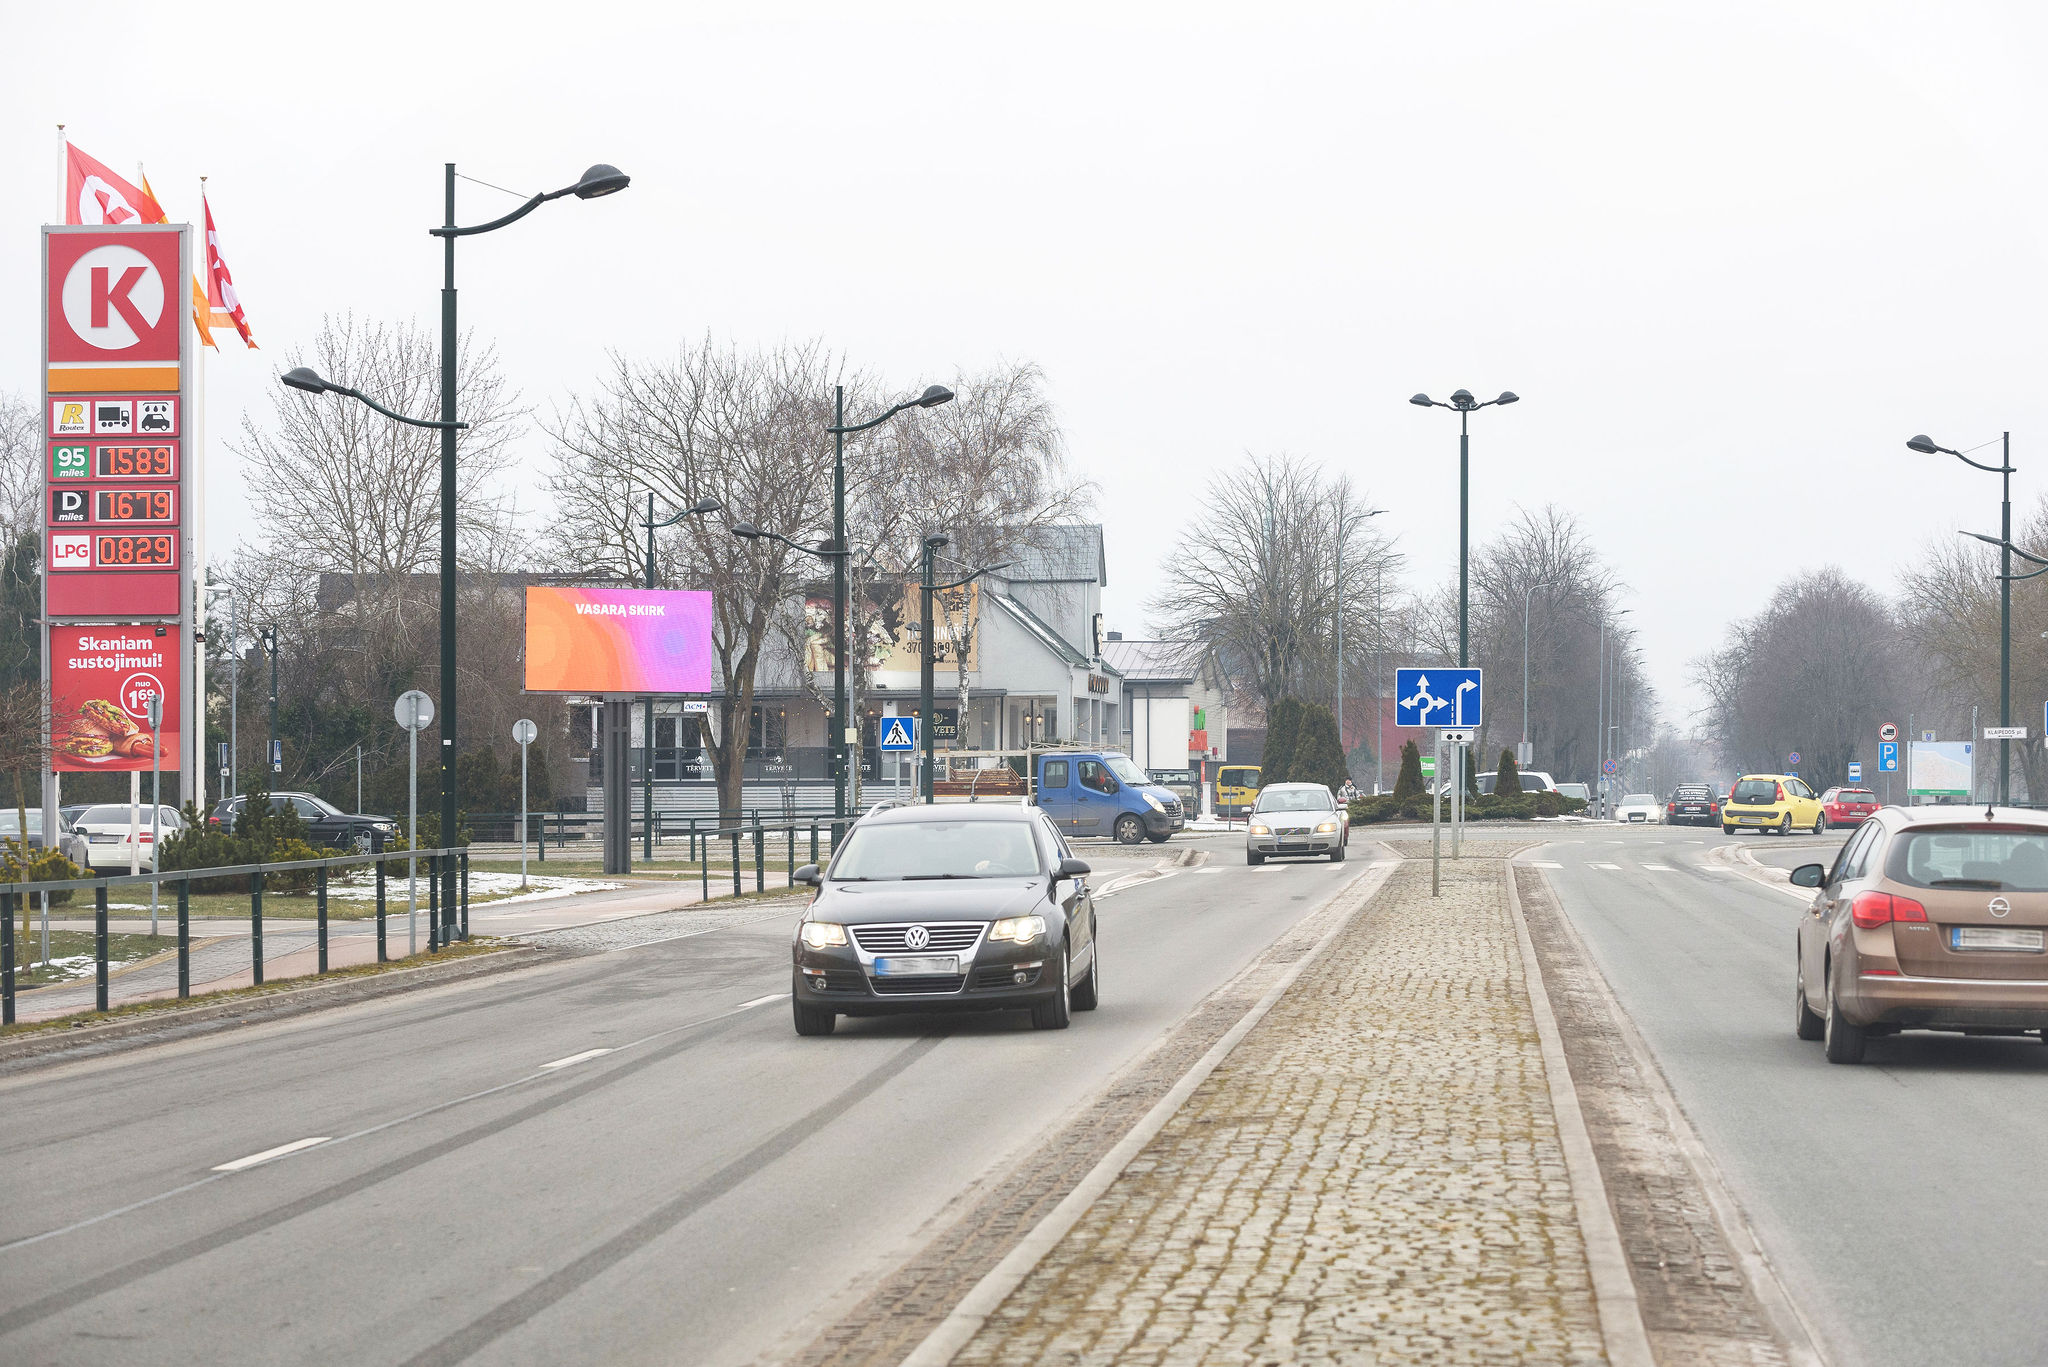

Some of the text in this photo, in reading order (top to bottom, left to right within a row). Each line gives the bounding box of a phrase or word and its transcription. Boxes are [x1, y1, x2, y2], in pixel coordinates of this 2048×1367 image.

[91, 266, 154, 342] K
[58, 448, 85, 467] 95
[60, 469, 84, 477] miles
[62, 492, 82, 511] D
[58, 513, 84, 521] miles
[55, 544, 88, 559] LPG
[575, 603, 666, 617] VASARĄ SKIRK
[78, 635, 153, 651] Skaniam
[68, 652, 163, 672] sustojimui!
[1884, 744, 1894, 760] P
